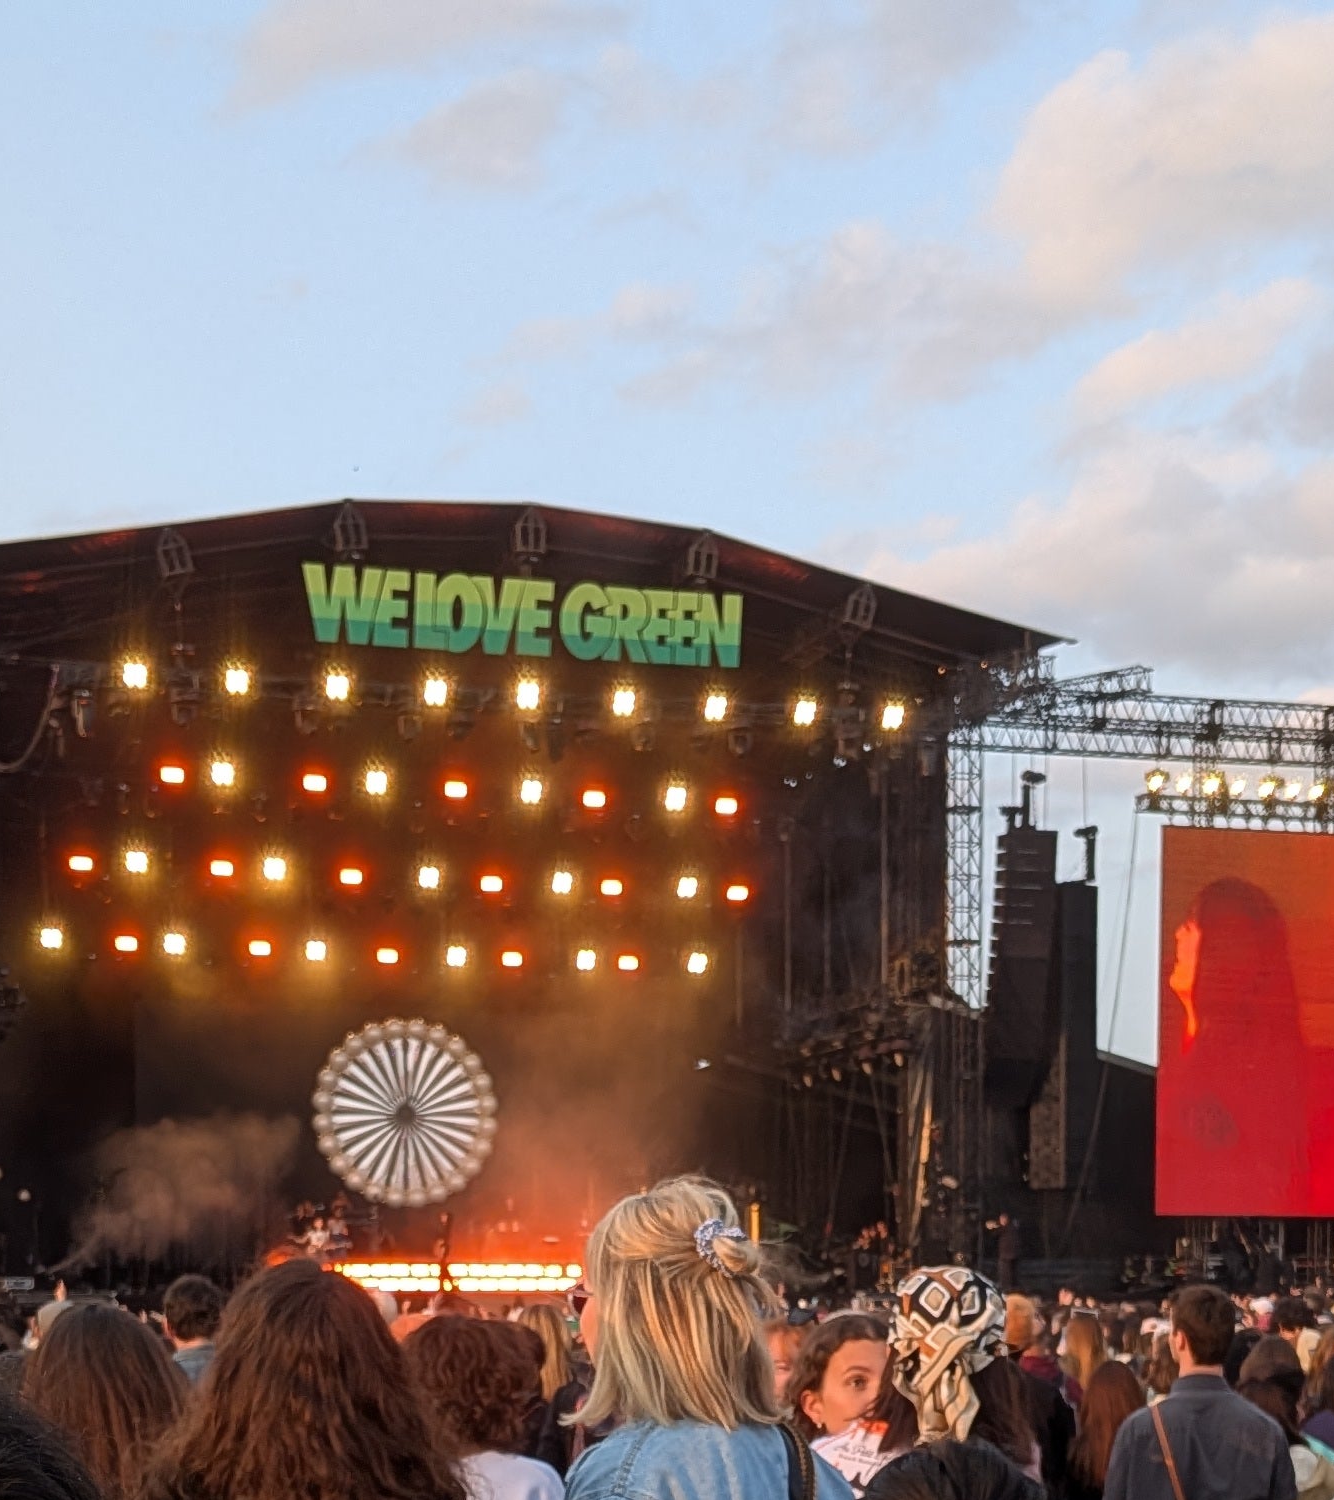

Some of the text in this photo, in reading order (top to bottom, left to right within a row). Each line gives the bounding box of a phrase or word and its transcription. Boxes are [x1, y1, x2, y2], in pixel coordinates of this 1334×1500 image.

[302, 561, 744, 669] WE LOVE GREEN
